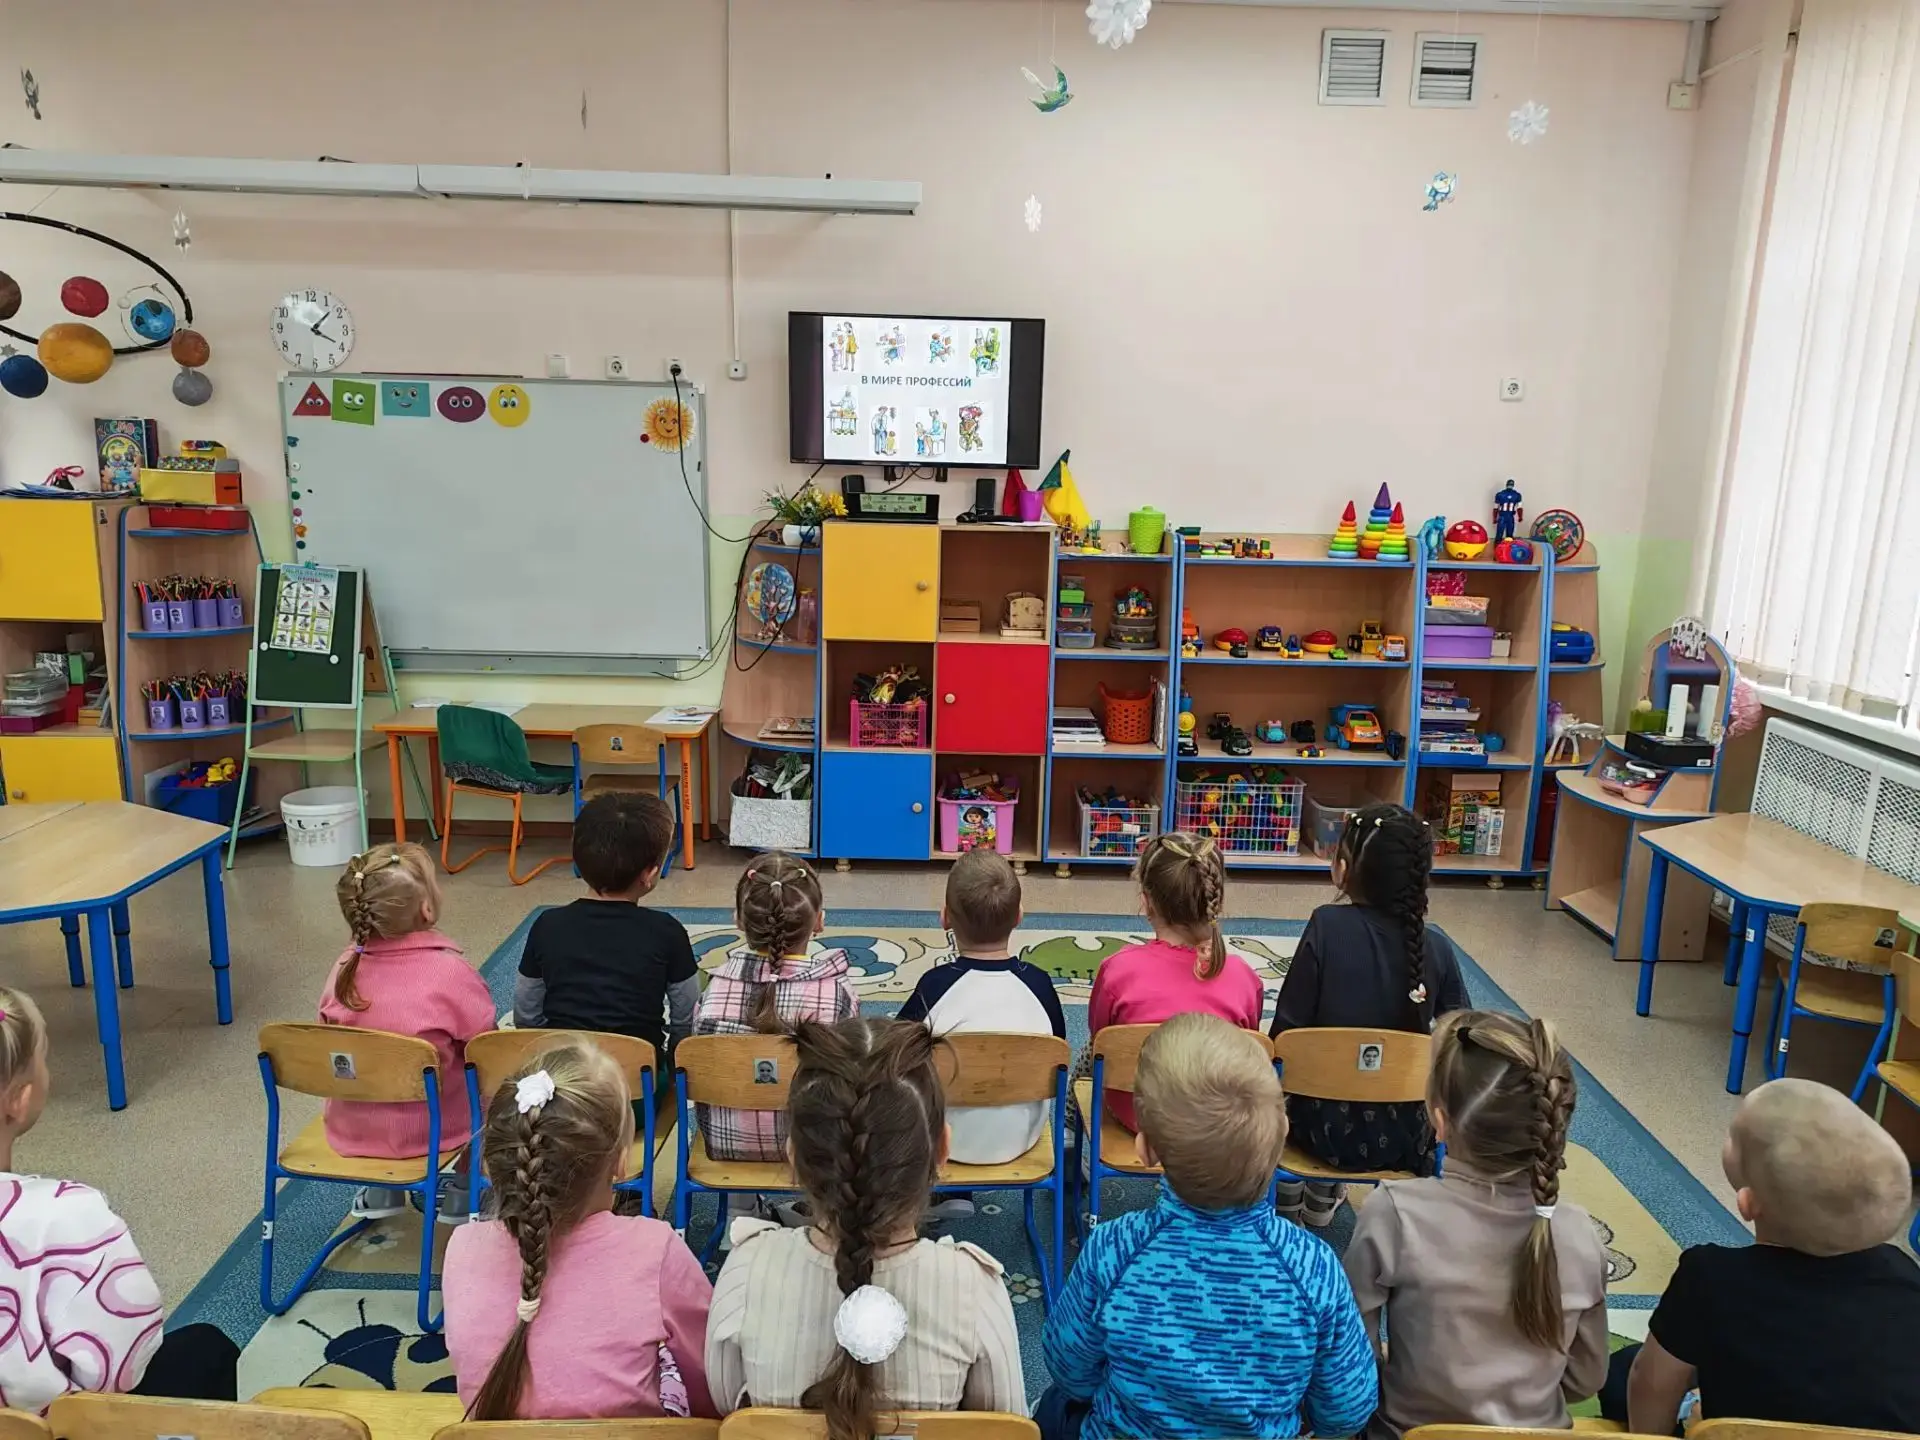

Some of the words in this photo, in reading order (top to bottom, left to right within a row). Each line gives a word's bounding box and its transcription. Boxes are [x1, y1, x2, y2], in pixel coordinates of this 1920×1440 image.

[291, 294, 299, 305] 11
[305, 290, 317, 303] 12
[323, 295, 330, 307] 1
[279, 307, 289, 318] 10
[336, 307, 343, 319] 2
[276, 322, 284, 334] 9
[342, 324, 349, 336] 3
[281, 340, 289, 352] 8
[338, 342, 345, 353] 4
[295, 353, 302, 365] 7
[312, 358, 319, 370] 6
[328, 353, 336, 366] 5
[861, 375, 868, 385] В
[871, 375, 902, 386] МИРЕ
[905, 375, 972, 388] ПРОФЕССИЙ
